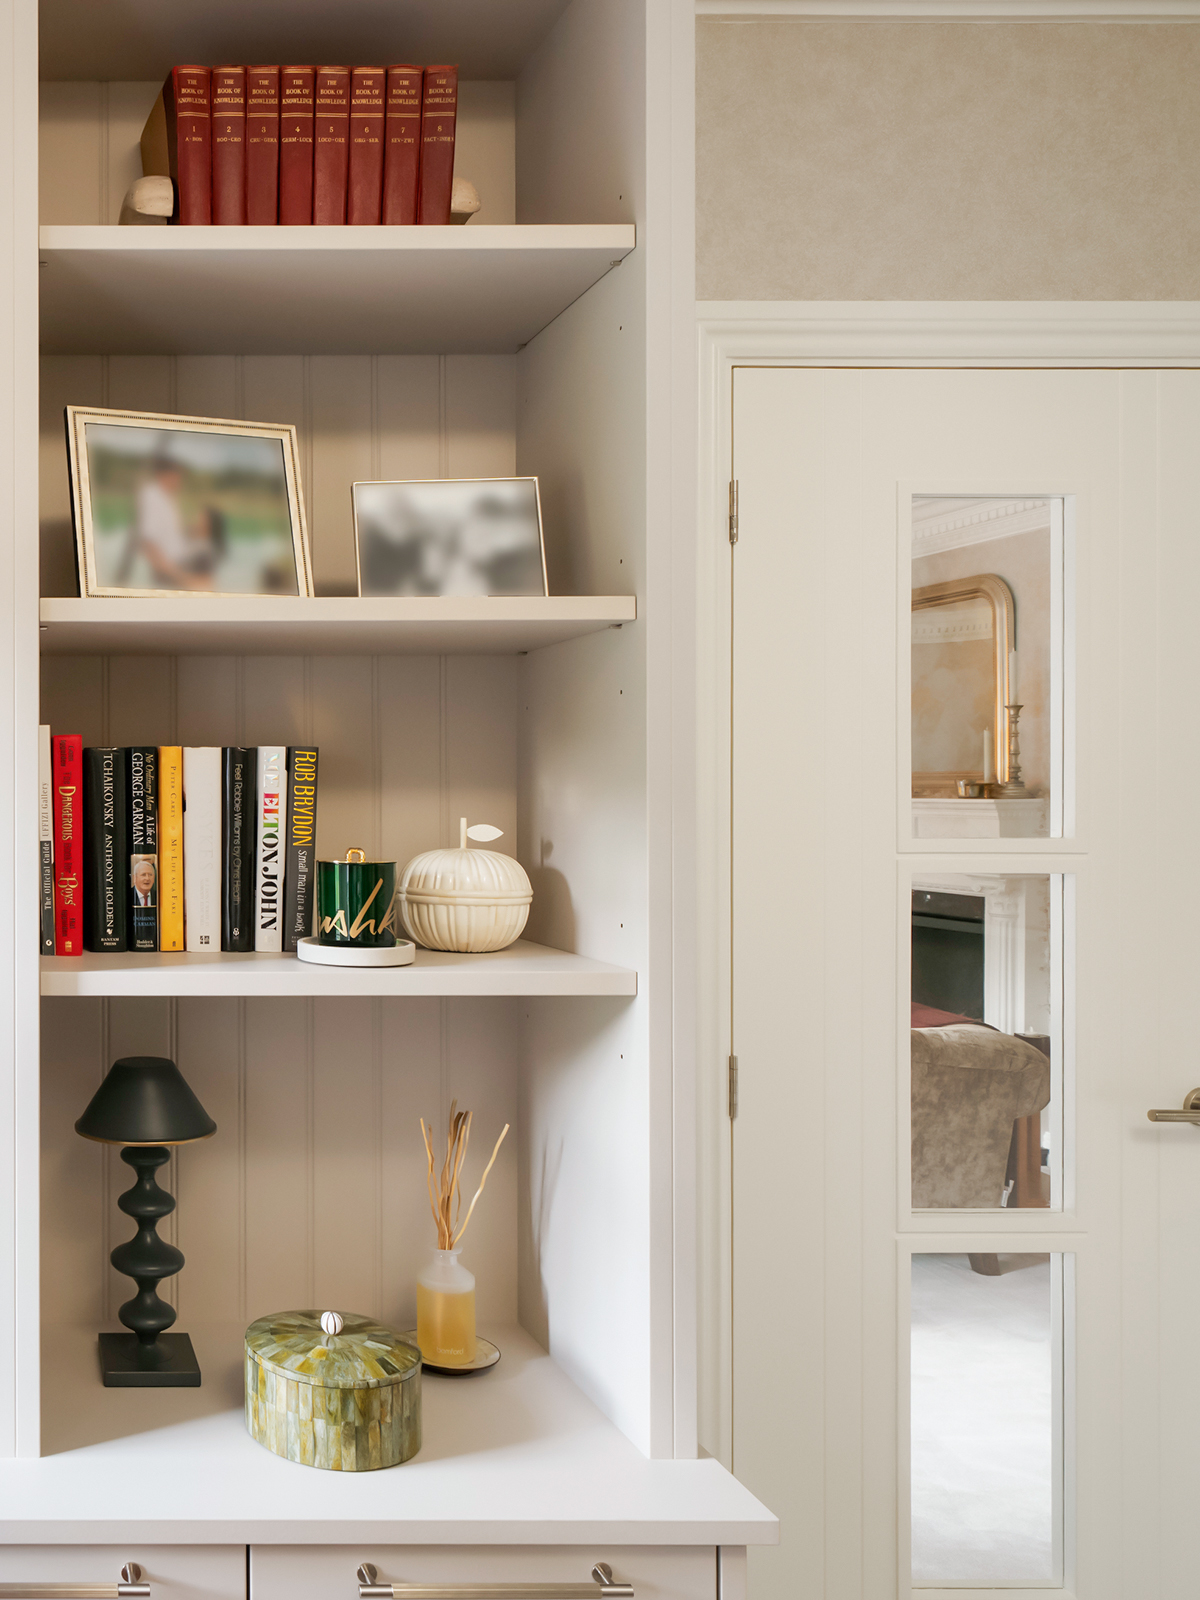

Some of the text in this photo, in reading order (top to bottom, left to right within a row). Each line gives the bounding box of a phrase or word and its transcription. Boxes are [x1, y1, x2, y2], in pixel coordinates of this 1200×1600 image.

[145, 753, 154, 766] No
[294, 750, 317, 782] ROB
[63, 772, 72, 784] The
[104, 753, 114, 828] TCHAIKOVSKY
[144, 768, 155, 794] Ordinary
[41, 782, 49, 809] Gallery
[132, 752, 144, 845] GEORGE CARMAN
[146, 795, 154, 812] Man
[262, 792, 280, 864] ELTON
[292, 786, 315, 846] BRYDON
[146, 823, 155, 838] Life
[232, 764, 243, 906] Feel Robbie Williams by Chris Heath
[297, 875, 306, 893] man
[260, 866, 278, 930] JOHN
[297, 895, 306, 904] in
[294, 912, 305, 932] book
[436, 1346, 464, 1355] bamford
